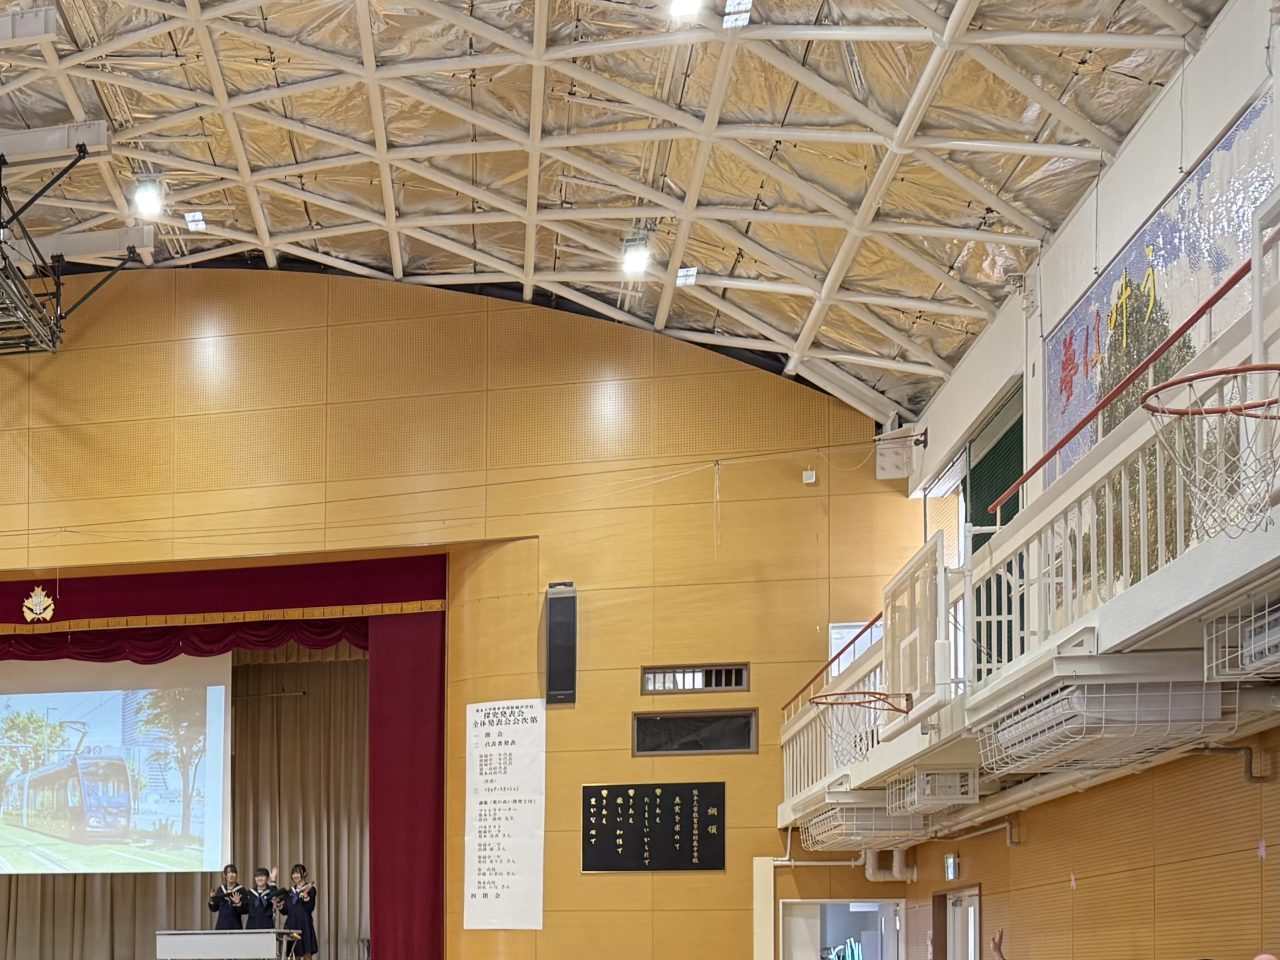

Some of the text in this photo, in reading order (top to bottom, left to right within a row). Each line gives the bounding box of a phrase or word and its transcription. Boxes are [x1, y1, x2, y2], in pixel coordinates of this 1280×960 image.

[484, 710, 524, 719] 探究発表会
[473, 716, 538, 728] 全体発表会会次第
[707, 806, 718, 834] 綱領
